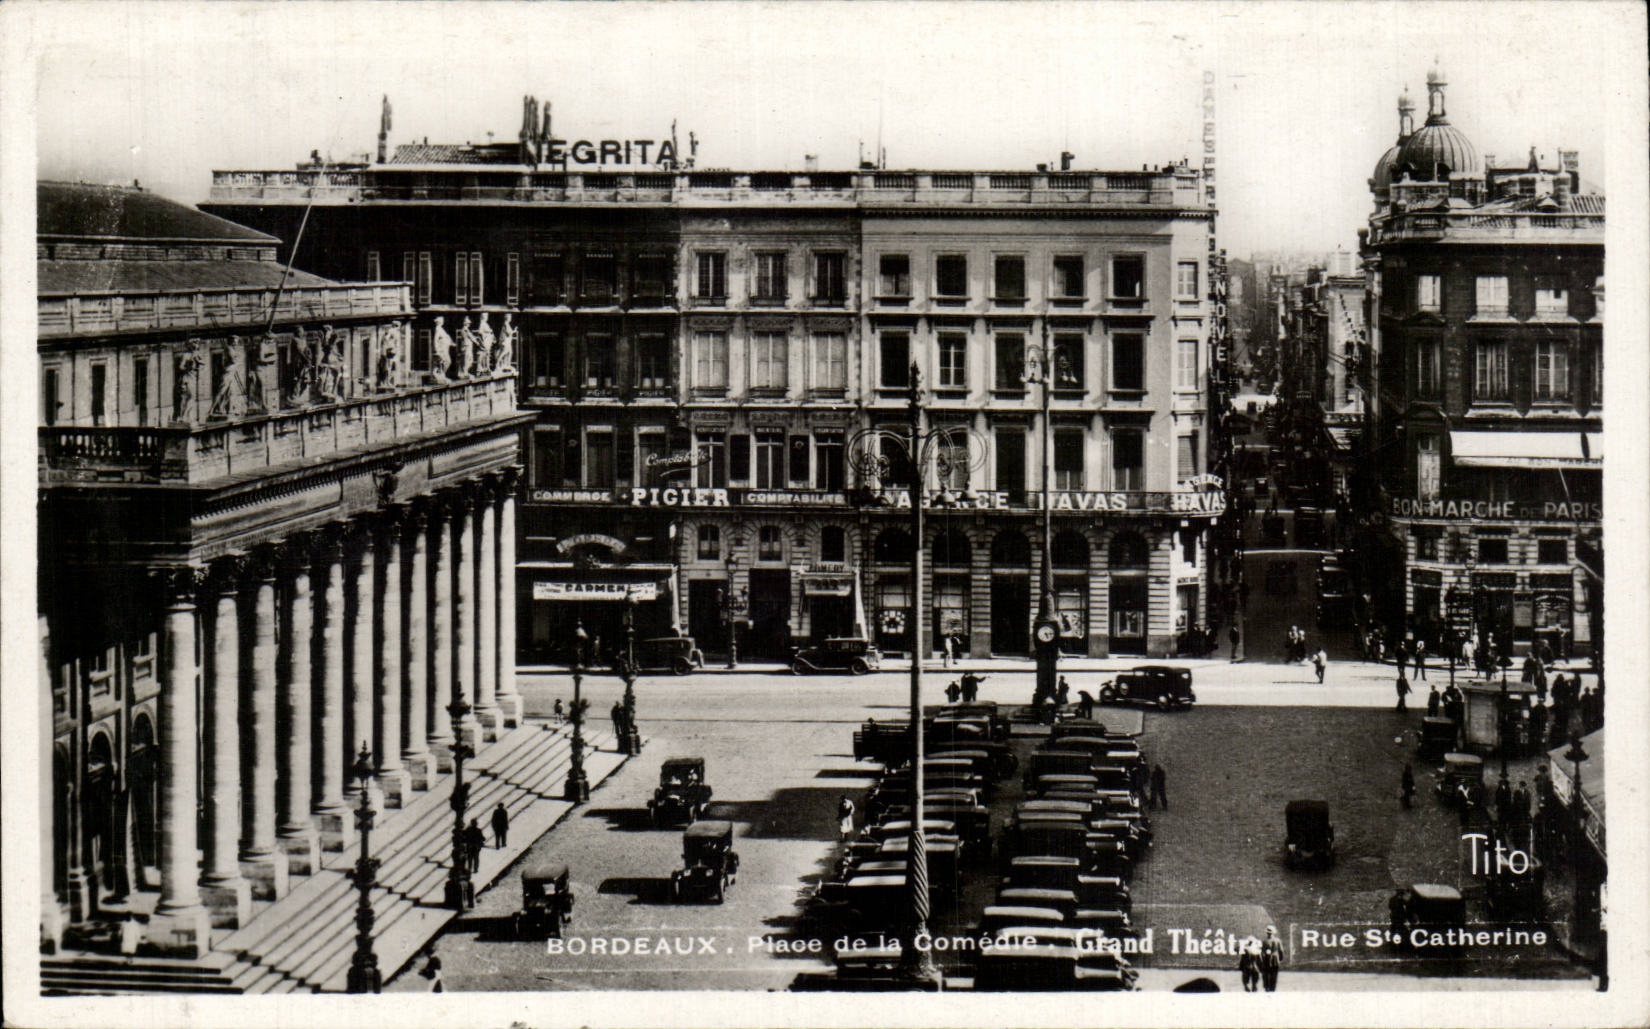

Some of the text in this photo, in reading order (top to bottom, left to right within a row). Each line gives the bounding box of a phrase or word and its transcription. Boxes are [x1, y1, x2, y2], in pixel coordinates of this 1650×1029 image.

[522, 140, 677, 164] NEGRITA
[1216, 281, 1227, 426] NOVELTY
[631, 488, 730, 506] PIGIER
[1170, 490, 1227, 512] HAVAS
[1393, 498, 1423, 517] BON
[1429, 500, 1515, 518] MARCHE
[1544, 501, 1602, 519] PARIS
